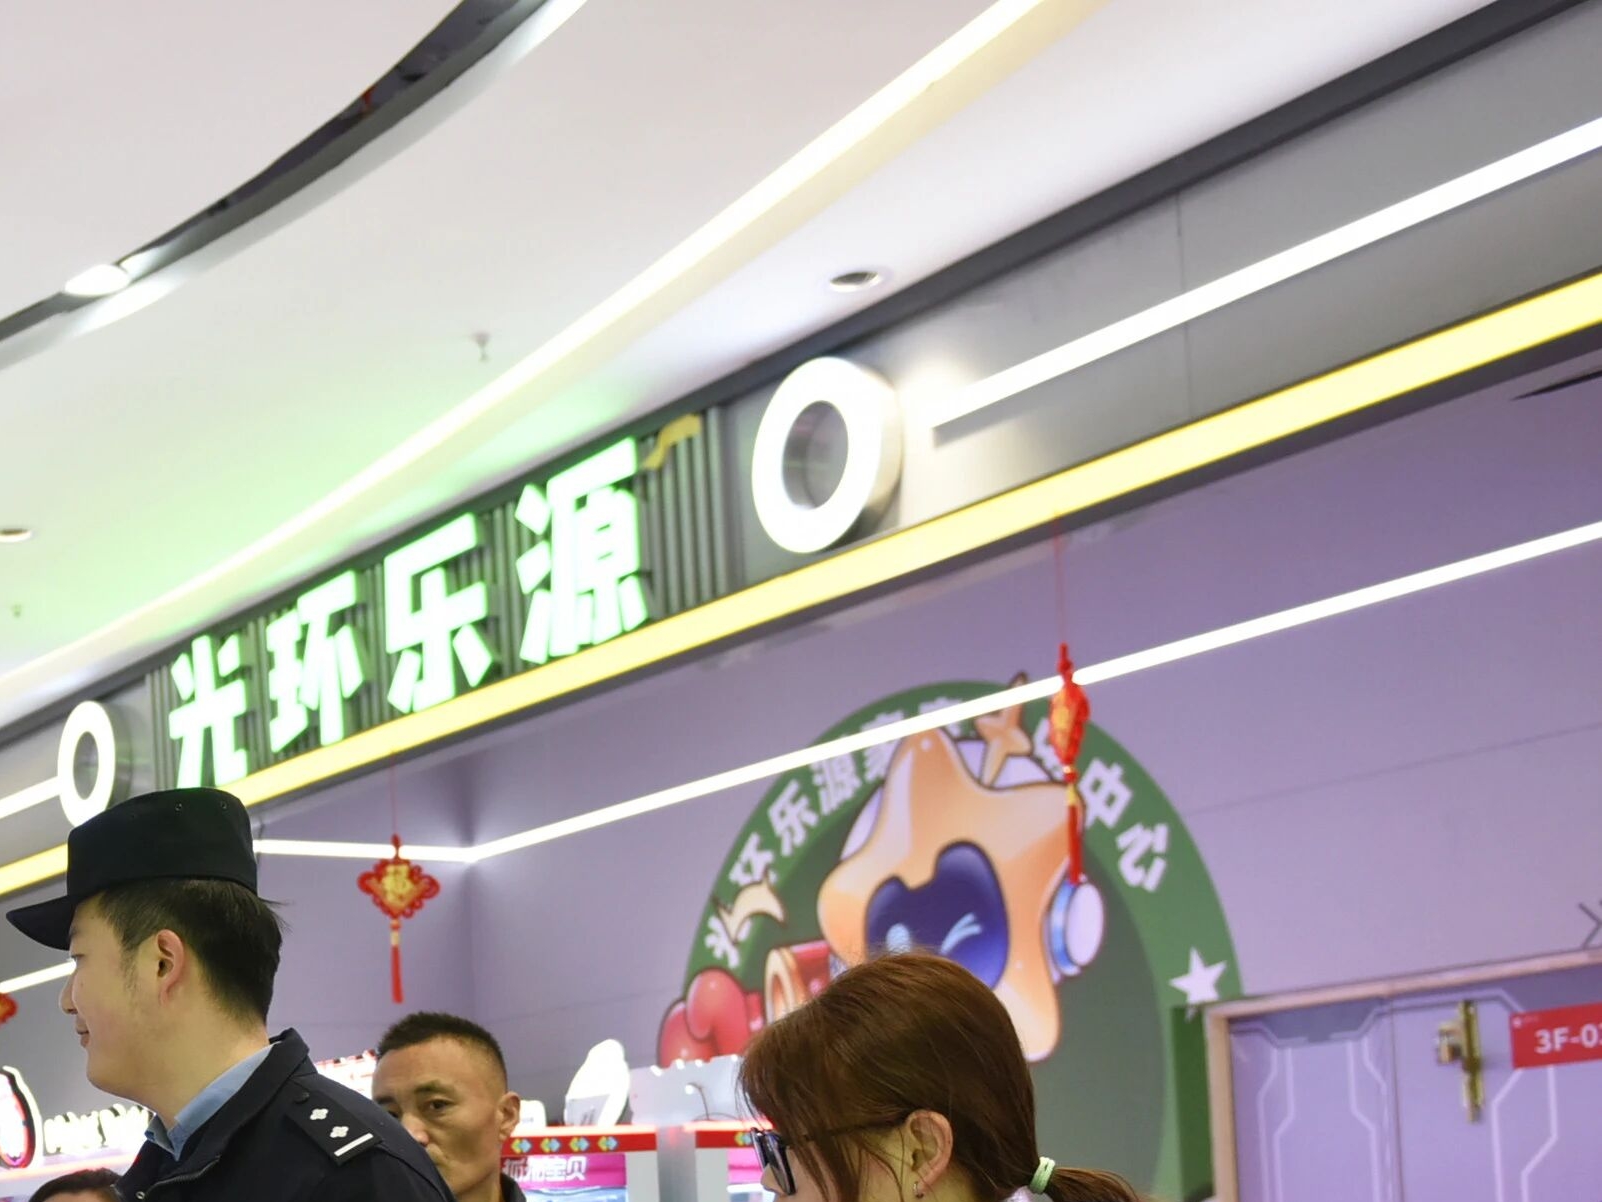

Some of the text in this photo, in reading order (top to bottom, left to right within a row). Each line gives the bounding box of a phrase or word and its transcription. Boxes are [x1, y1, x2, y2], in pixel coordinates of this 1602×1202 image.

[167, 435, 651, 789] 光环乐源
[704, 698, 1170, 969] 光环乐源家中心
[1534, 1022, 1602, 1055] 3F-0
